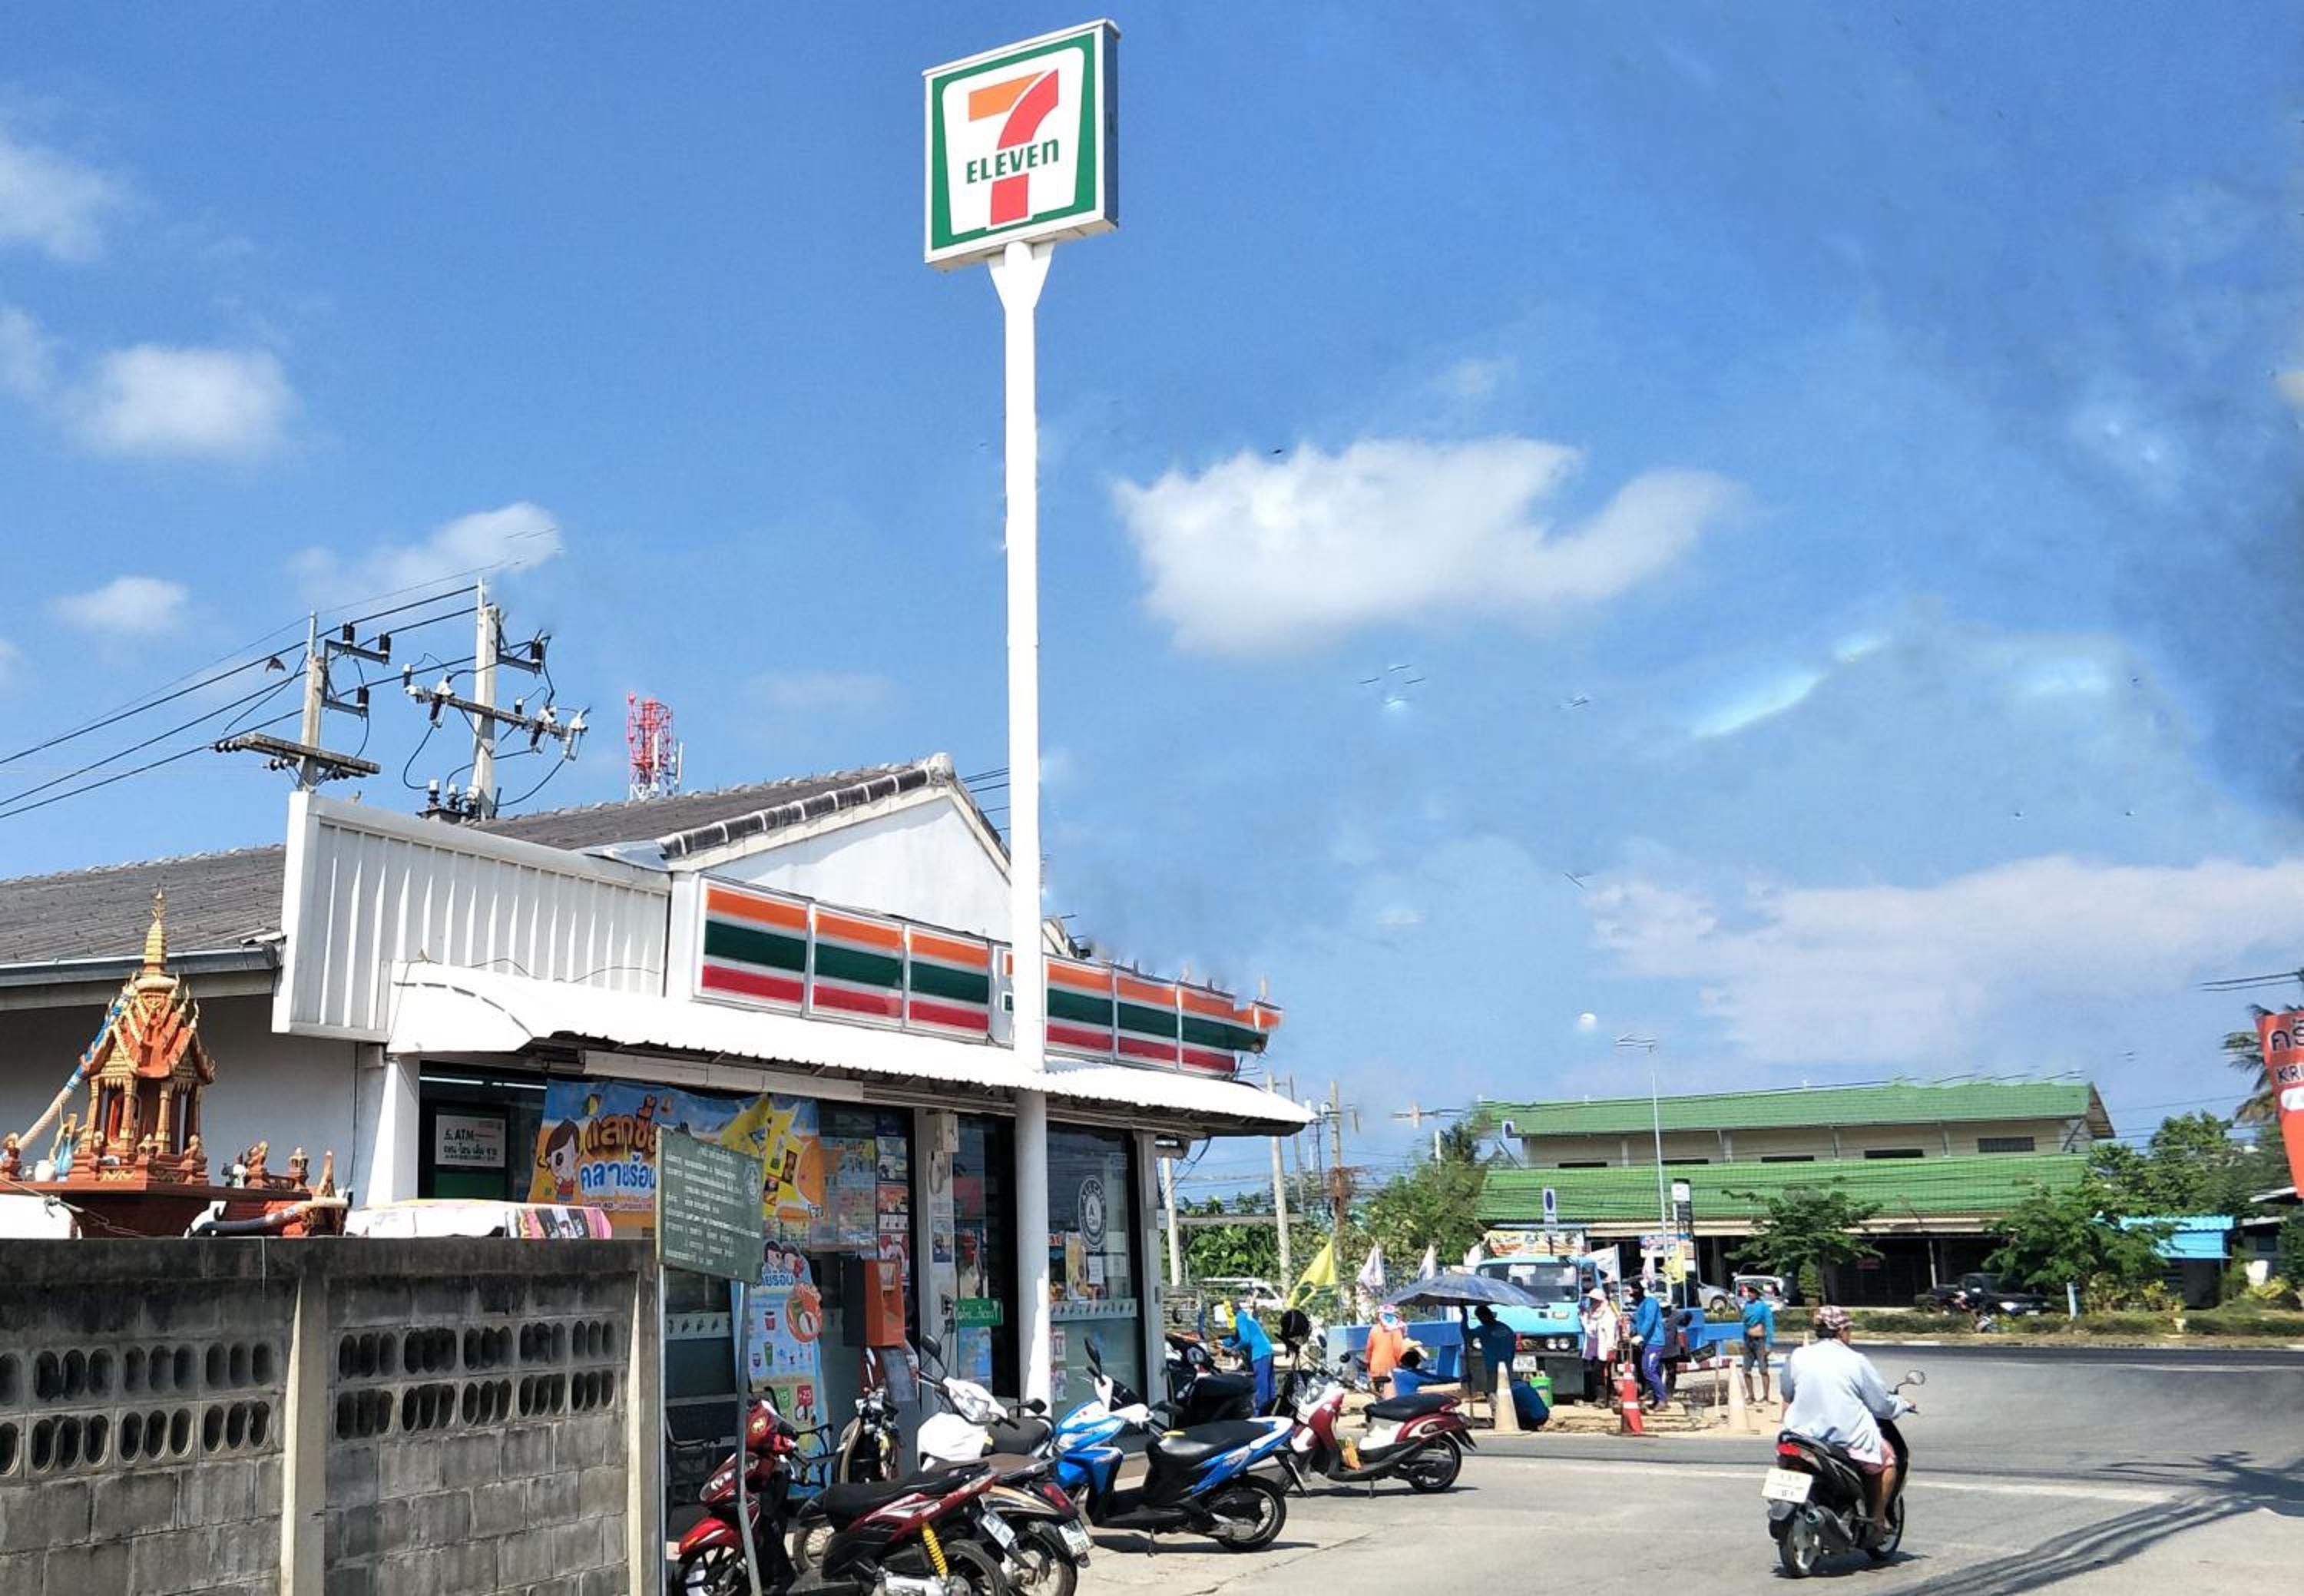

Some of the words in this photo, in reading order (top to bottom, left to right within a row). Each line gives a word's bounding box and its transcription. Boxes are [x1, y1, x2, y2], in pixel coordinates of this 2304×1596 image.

[968, 68, 1059, 226] 7
[2276, 1065, 2304, 1084] KR
[454, 1128, 475, 1141] ATM
